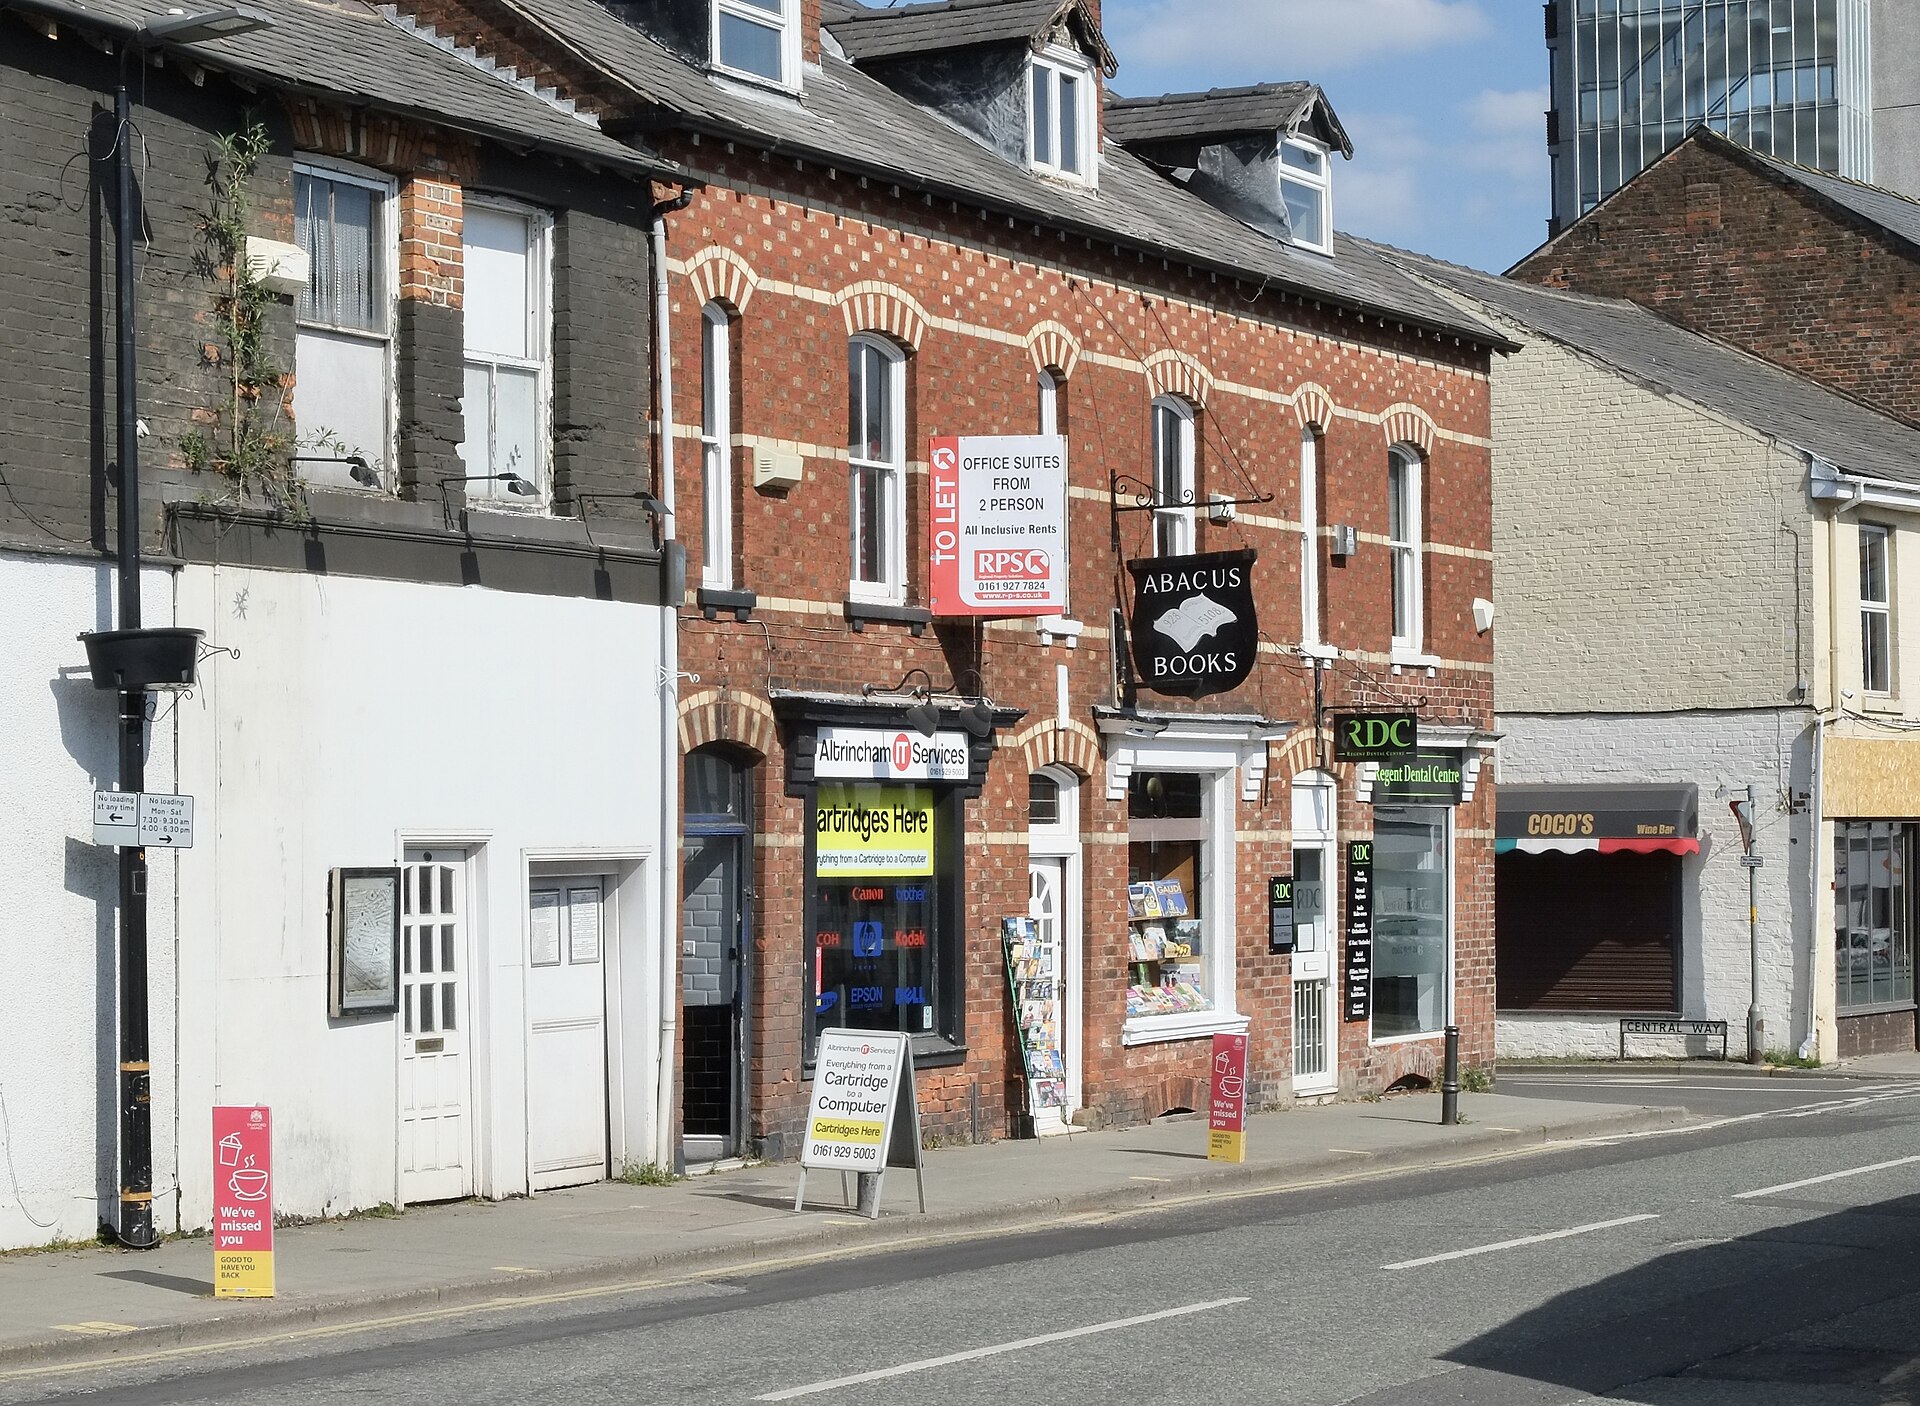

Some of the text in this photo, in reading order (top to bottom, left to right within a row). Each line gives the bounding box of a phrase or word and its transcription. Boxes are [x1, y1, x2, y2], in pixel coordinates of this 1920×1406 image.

[963, 455, 1060, 471] OFFICE SUITES
[993, 477, 1030, 491] FROM
[979, 497, 1044, 512] 2 PERSON
[935, 475, 956, 566] TO LET
[965, 523, 1057, 536] All Inclusive Rents
[979, 552, 1024, 573] RPS
[978, 581, 1045, 591] 0161 927 7824
[1143, 567, 1241, 594] ABACUS
[982, 592, 1043, 600] www.r-p-s.co.uk
[1163, 607, 1222, 629] 928 5108
[1154, 652, 1237, 677] BOOKS
[1341, 718, 1411, 748] RDC
[819, 739, 965, 765] Altrincham IT Services
[1404, 765, 1431, 783] Dental
[1433, 765, 1460, 783] Centre
[110, 795, 134, 804] loading
[161, 798, 184, 807] loading
[106, 804, 118, 812] any
[143, 816, 158, 824] 7.30
[163, 816, 179, 825] 9.30
[894, 804, 928, 833] Here
[1527, 813, 1594, 836] COCO'S
[163, 825, 179, 833] 6.30
[1637, 824, 1675, 835] Wine Bar
[1352, 844, 1370, 860] RDC
[840, 853, 853, 864] from
[860, 853, 885, 866] Cartridge
[886, 854, 893, 864] to
[900, 853, 926, 866] Computer
[852, 886, 926, 901] Canon brother
[1274, 883, 1291, 899] RDC
[895, 930, 925, 946] Kodak
[851, 986, 882, 1003] EPSON
[895, 986, 925, 1005] DELL
[1627, 1021, 1720, 1034] CENTRAL WAY
[827, 1044, 861, 1053] Altrincham
[870, 1046, 896, 1055] Services
[826, 1059, 867, 1071] Everything
[868, 1062, 885, 1070] from
[824, 1071, 888, 1092] Cartridge
[846, 1090, 855, 1098] to
[818, 1096, 887, 1116] Computer
[1213, 1100, 1234, 1109] We've
[1213, 1109, 1237, 1118] missed
[815, 1122, 880, 1137] Cartridges Here
[1212, 1119, 1226, 1127] you
[813, 1144, 876, 1160] 0161 929 5003
[220, 1206, 255, 1218] We've
[221, 1219, 262, 1232] missed
[221, 1235, 243, 1247] you
